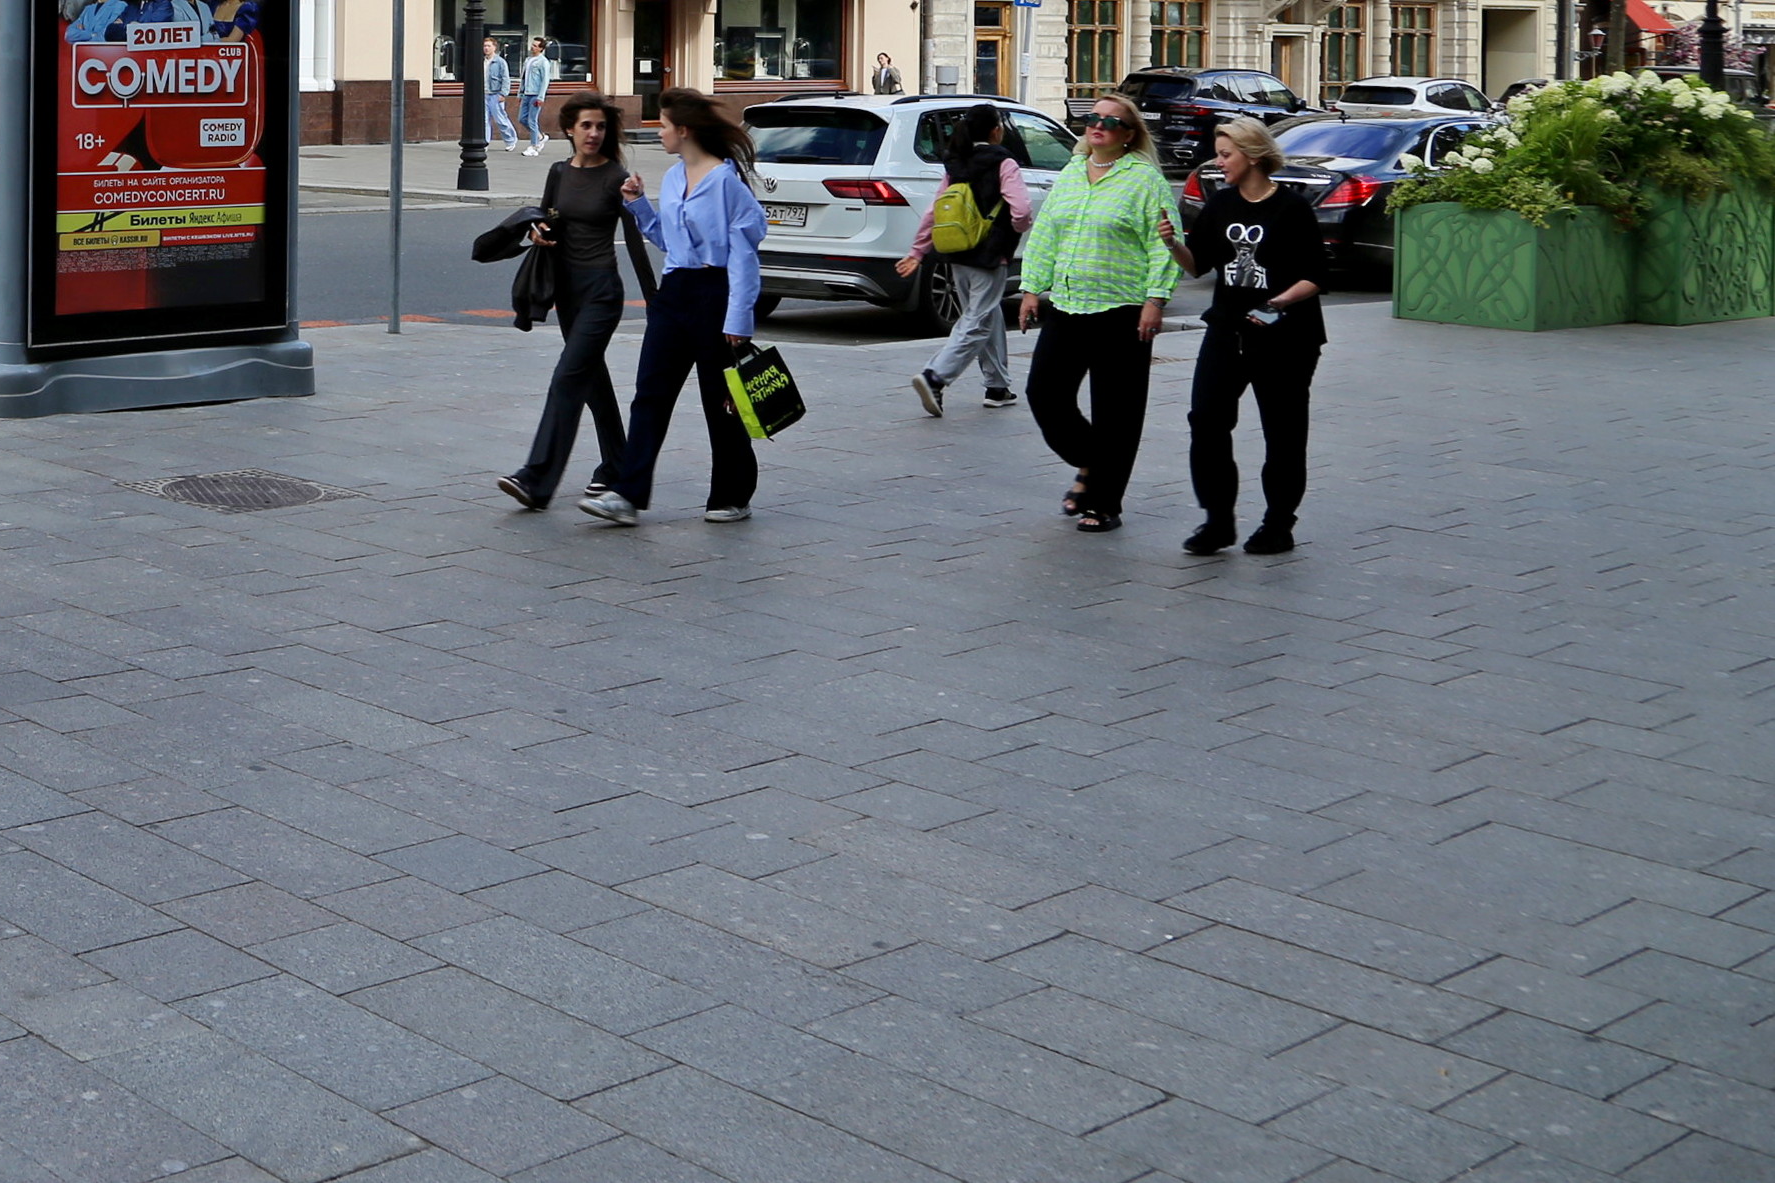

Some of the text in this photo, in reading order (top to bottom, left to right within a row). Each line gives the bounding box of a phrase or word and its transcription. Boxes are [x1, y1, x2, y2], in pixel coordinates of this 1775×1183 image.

[133, 27, 194, 45] 20 ЛЕТ
[218, 47, 242, 57] CLUB
[78, 57, 243, 96] COMEDY
[202, 122, 243, 133] COMEDY
[74, 132, 106, 151] 18+
[207, 132, 238, 143] RADIO
[94, 175, 226, 188] БИЛЕТЫ НА САЙТЕ ОРГАНИЗАТОРА
[93, 188, 226, 205] COMEDYCONCERT.RU
[130, 211, 243, 227] Билеты Яндекс Афиша
[73, 238, 85, 246] ВСЕ
[85, 236, 110, 246] БИЛЕТЫ
